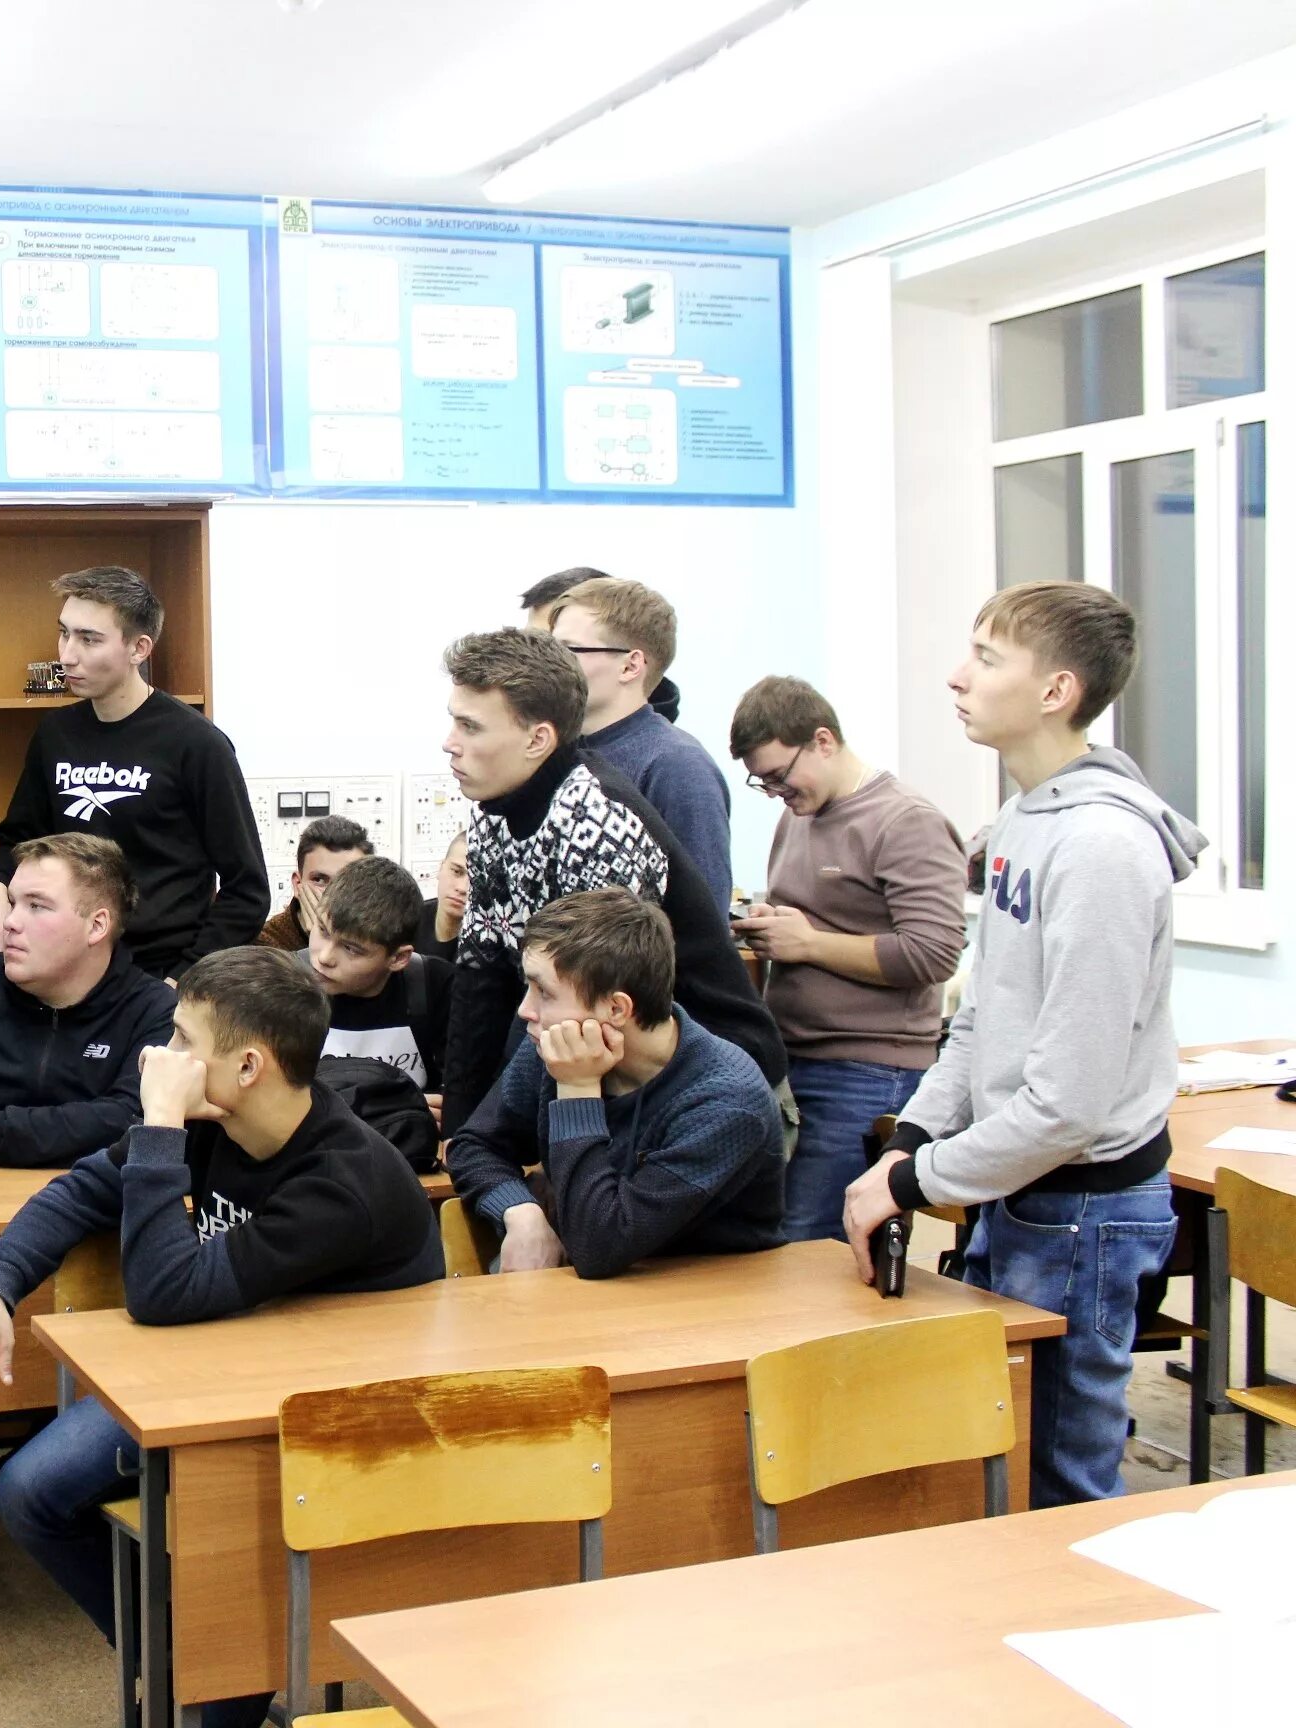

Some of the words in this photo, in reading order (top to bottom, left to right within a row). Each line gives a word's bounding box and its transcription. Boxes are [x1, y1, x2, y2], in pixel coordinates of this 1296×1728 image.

[54, 202, 127, 214] асинхронным
[373, 215, 422, 228] ОСНОВЫ
[425, 218, 521, 233] ЭЛЕКТРОПРИВОДА
[24, 229, 82, 240] Торможение
[84, 232, 150, 242] асинхронного
[152, 235, 196, 243] двигателя
[17, 240, 34, 249] При
[36, 242, 79, 250] включении
[55, 761, 152, 790] Reebok
